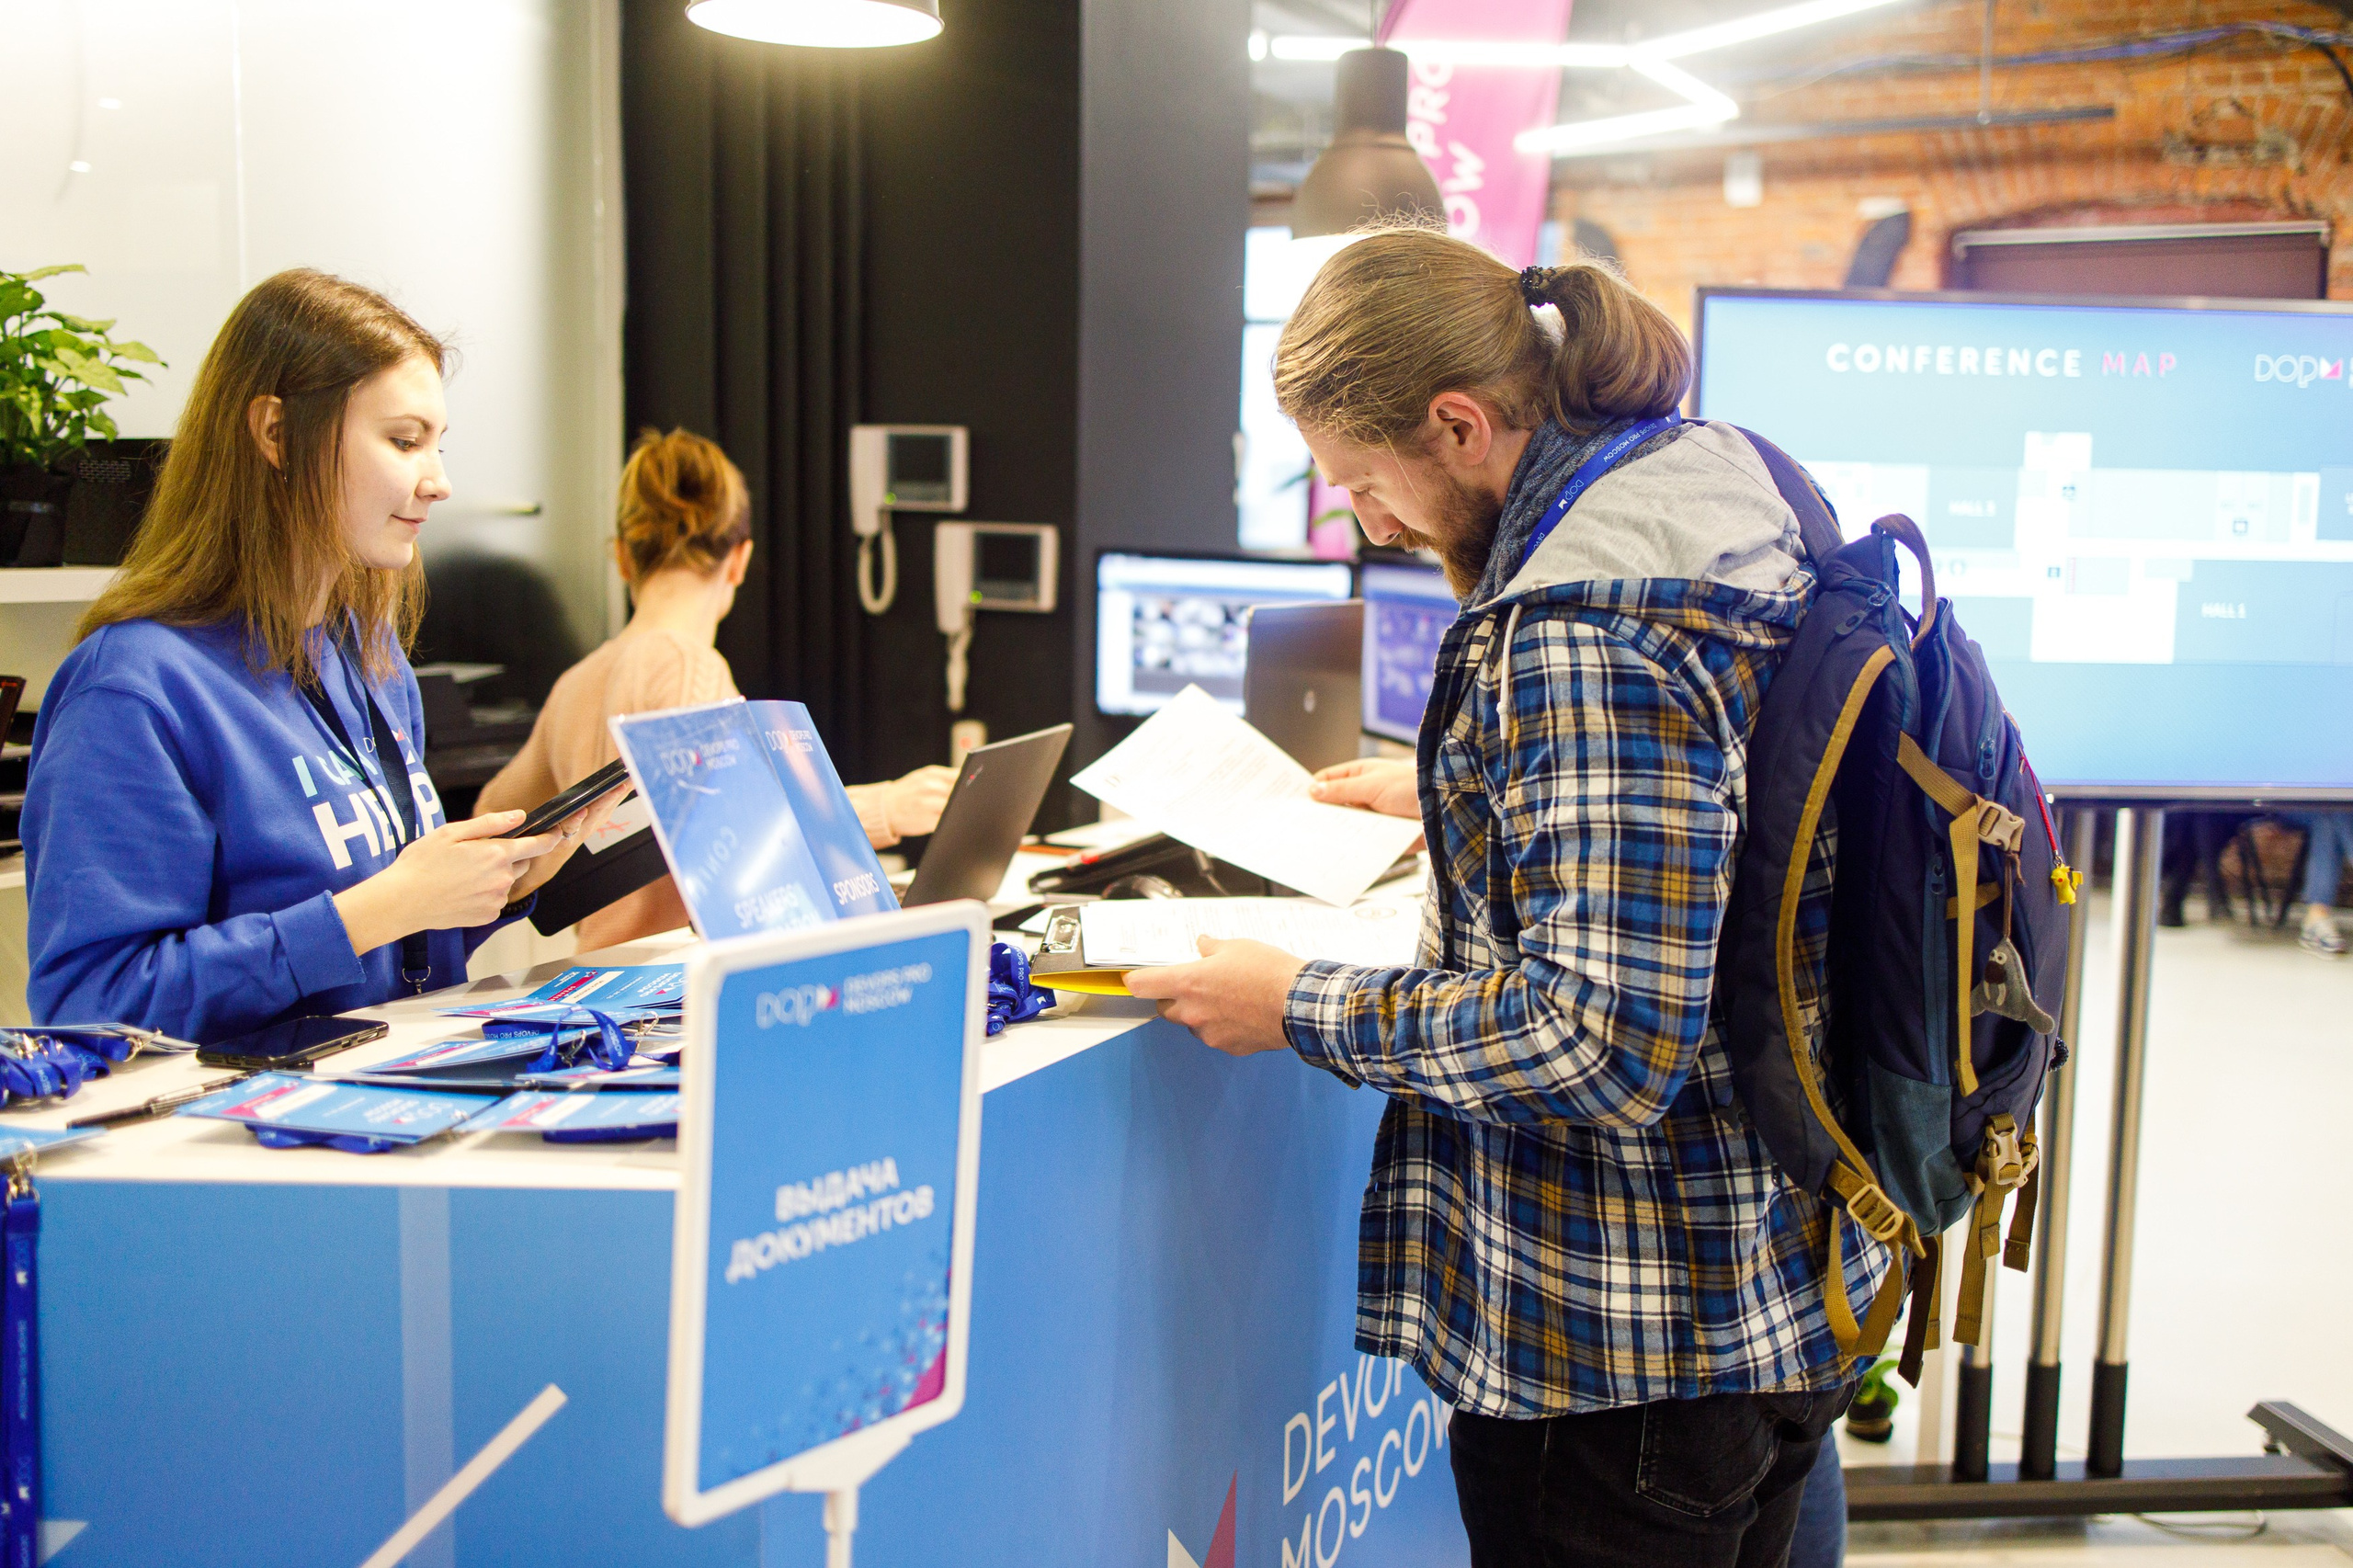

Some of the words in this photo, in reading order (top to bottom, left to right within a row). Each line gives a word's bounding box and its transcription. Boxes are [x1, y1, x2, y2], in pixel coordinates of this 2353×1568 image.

[1826, 342, 2082, 378] CONFERENCE
[2102, 351, 2177, 377] MAP
[1604, 440, 1631, 462] MOSCOW
[1629, 433, 1641, 442] PRO
[292, 756, 318, 798] I
[834, 872, 880, 905] SPONSORS
[775, 1155, 900, 1223] ВЫДАЧА
[726, 1185, 935, 1283] ДОКУМЕНТОВ
